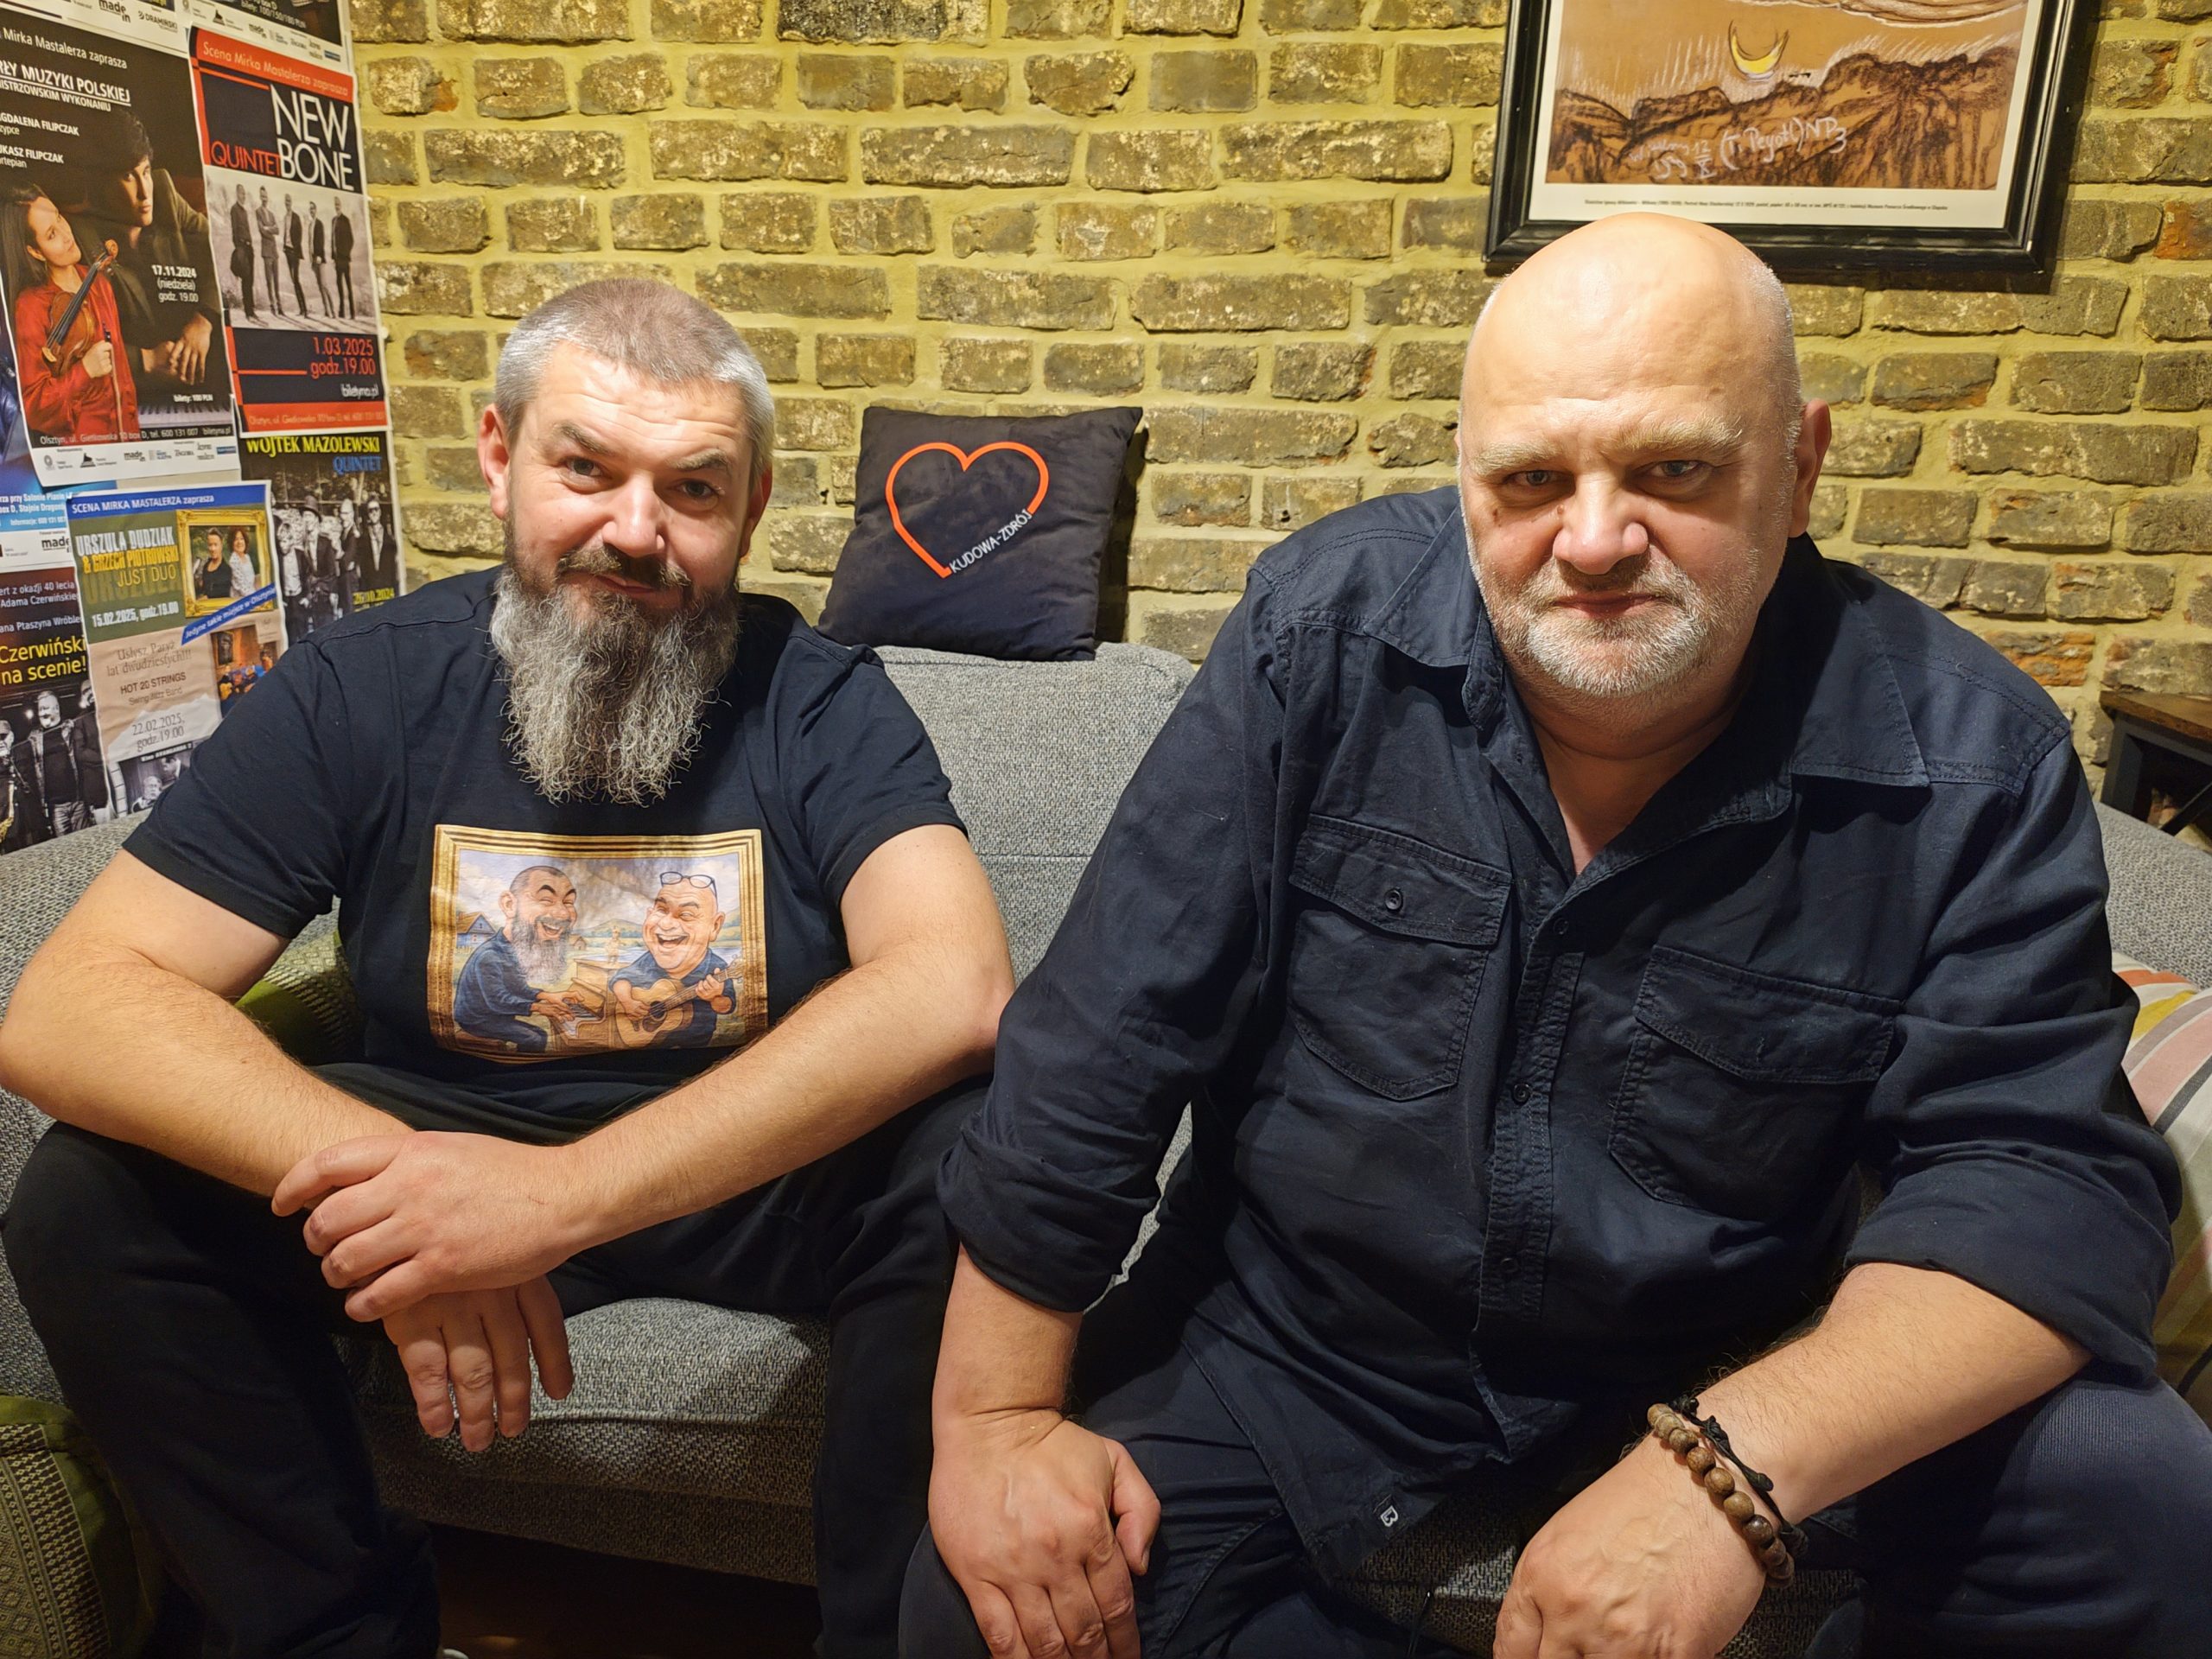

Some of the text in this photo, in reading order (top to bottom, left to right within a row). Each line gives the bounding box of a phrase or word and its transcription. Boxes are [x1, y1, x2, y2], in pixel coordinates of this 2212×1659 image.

[3, 27, 127, 69] Mirka Mastalerza zaprasza
[203, 41, 232, 62] Scena
[234, 54, 260, 71] Mirka
[264, 60, 311, 84] Mastalerza
[21, 64, 74, 91] MUZYKI
[76, 77, 130, 103] POLSKIEJ
[60, 92, 111, 111] WYKONANIU
[270, 84, 349, 150] NEW
[41, 120, 79, 137] FILIPCZAK
[25, 149, 64, 164] FILIPCZAK
[211, 141, 282, 176] QUINTET
[276, 138, 354, 191] BONE
[151, 264, 197, 278] 17.11.2024
[157, 277, 196, 291] (niedziela)
[179, 292, 199, 302] 19.00
[313, 337, 373, 356] 1.03.2025
[246, 437, 301, 457] WOJTEK
[304, 436, 380, 453] MAZOLEWSKI
[333, 456, 382, 474] QUINTET
[72, 494, 215, 514] SCENA MIRKA MASTALERZA zaprasza
[74, 525, 175, 556] URSZULA DUDZIAK
[950, 508, 1033, 574] KUDOWA-ZDRÓJ
[82, 555, 92, 575] &
[126, 544, 181, 567] PIOTROWSKI
[118, 563, 177, 588] JUST DUO
[19, 582, 42, 594] okazji
[56, 581, 75, 589] lecia
[1, 598, 29, 607] Adama
[16, 620, 53, 631] Ptaszyna
[92, 608, 139, 627] 15.02.2025,
[186, 624, 207, 639] Jedyne
[0, 635, 87, 664] Czerwiński
[1, 655, 86, 685] na scenie!
[106, 665, 119, 677] lat
[120, 671, 187, 695] HOT 20 STRINGS
[132, 712, 186, 736] 22.02.2025,
